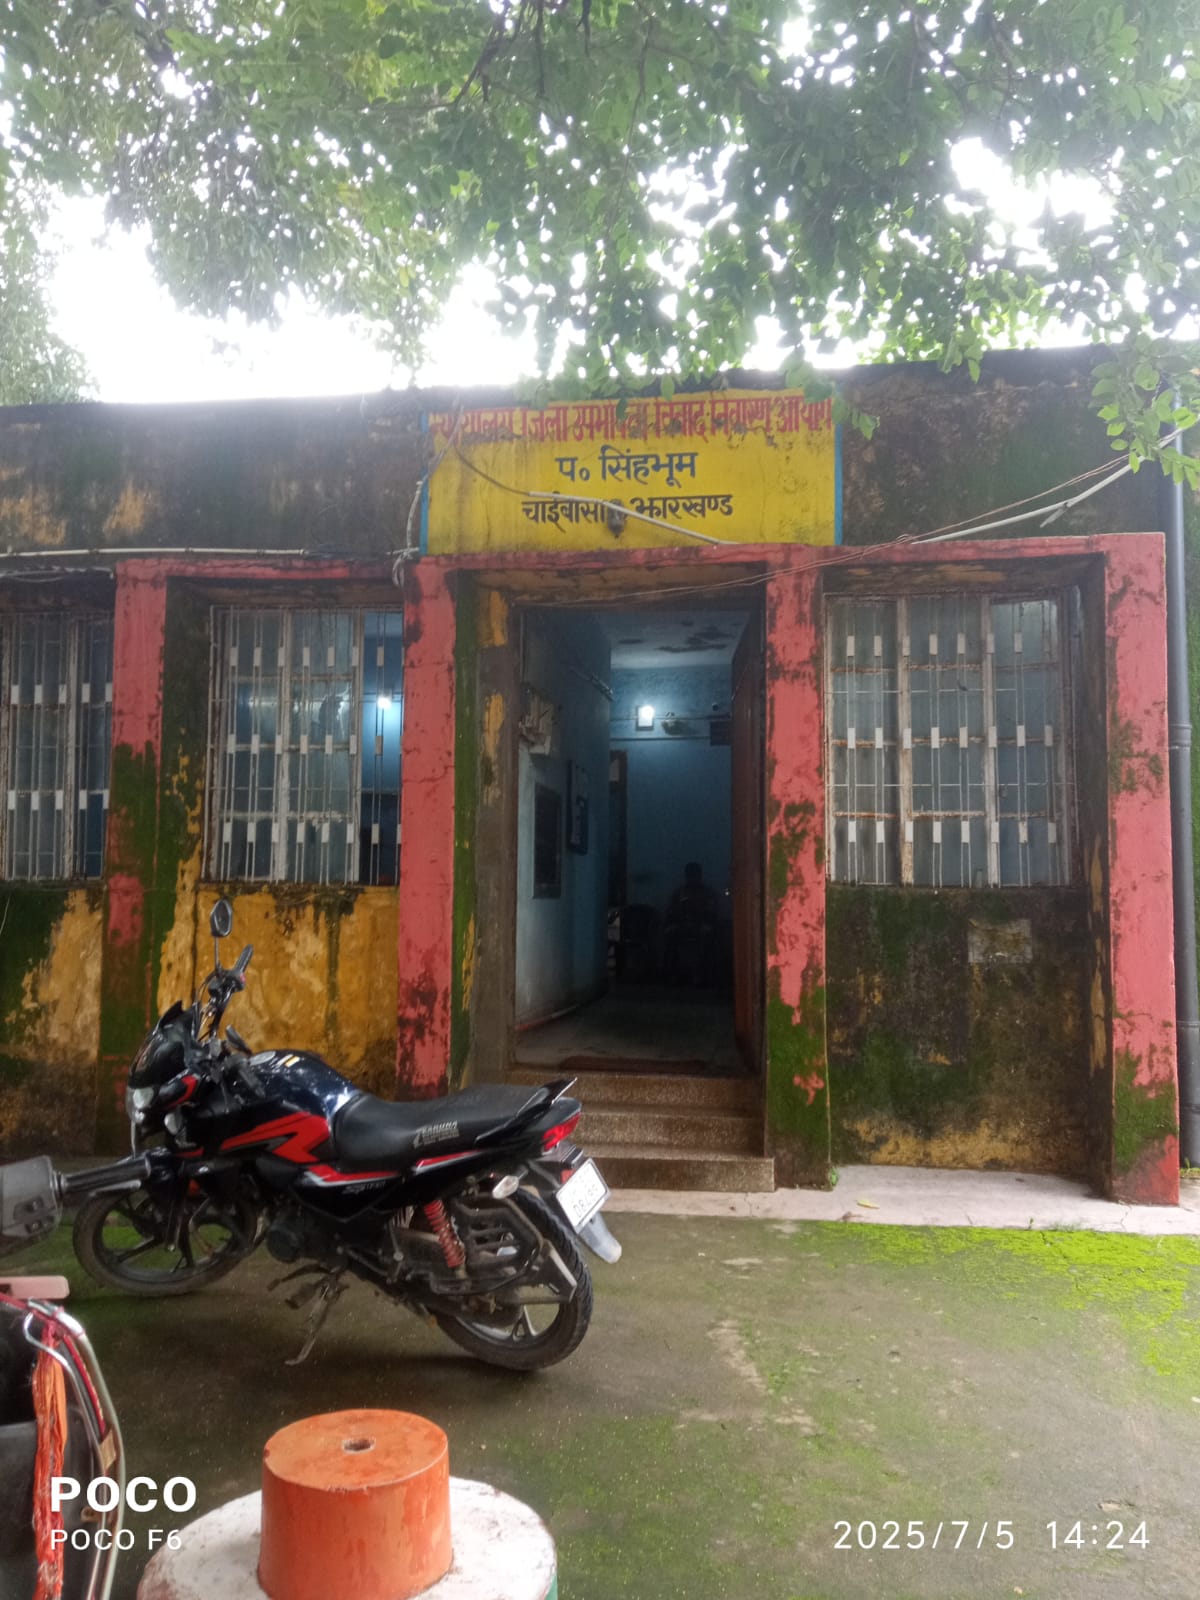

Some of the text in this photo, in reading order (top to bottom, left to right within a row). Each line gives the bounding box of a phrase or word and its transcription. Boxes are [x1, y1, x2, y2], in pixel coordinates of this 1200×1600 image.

[598, 445, 699, 489] सिंहभूम
[521, 490, 734, 533] चाईबासा झारखण्ड
